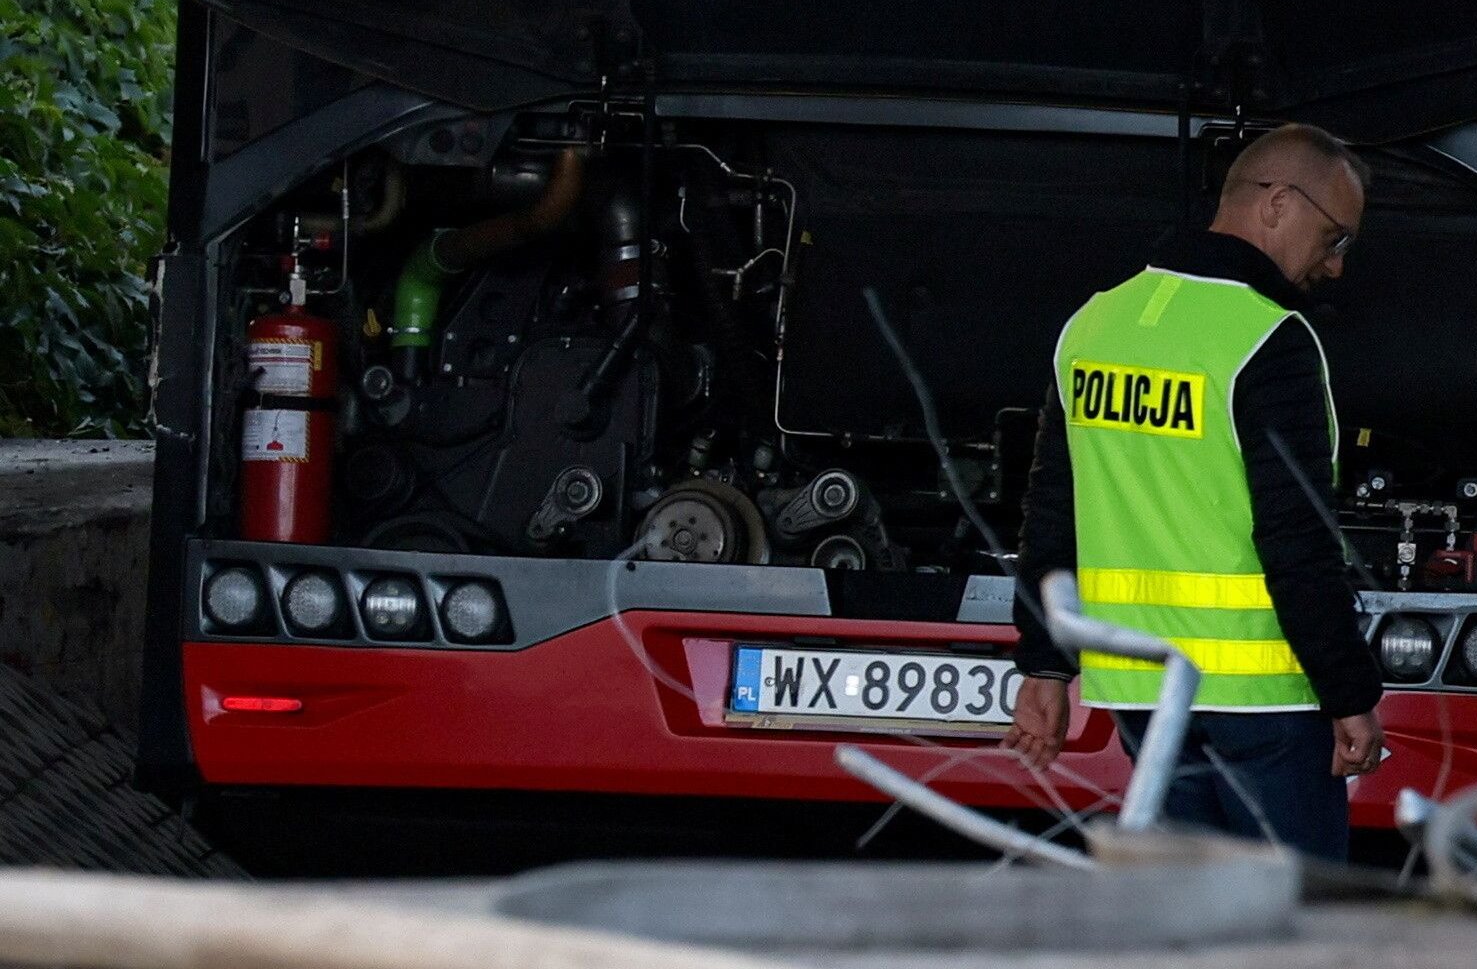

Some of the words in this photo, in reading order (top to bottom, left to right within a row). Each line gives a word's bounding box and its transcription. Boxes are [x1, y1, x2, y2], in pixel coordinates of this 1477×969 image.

[1072, 368, 1195, 431] POLICJA
[738, 686, 757, 702] PL
[774, 655, 841, 709] WX
